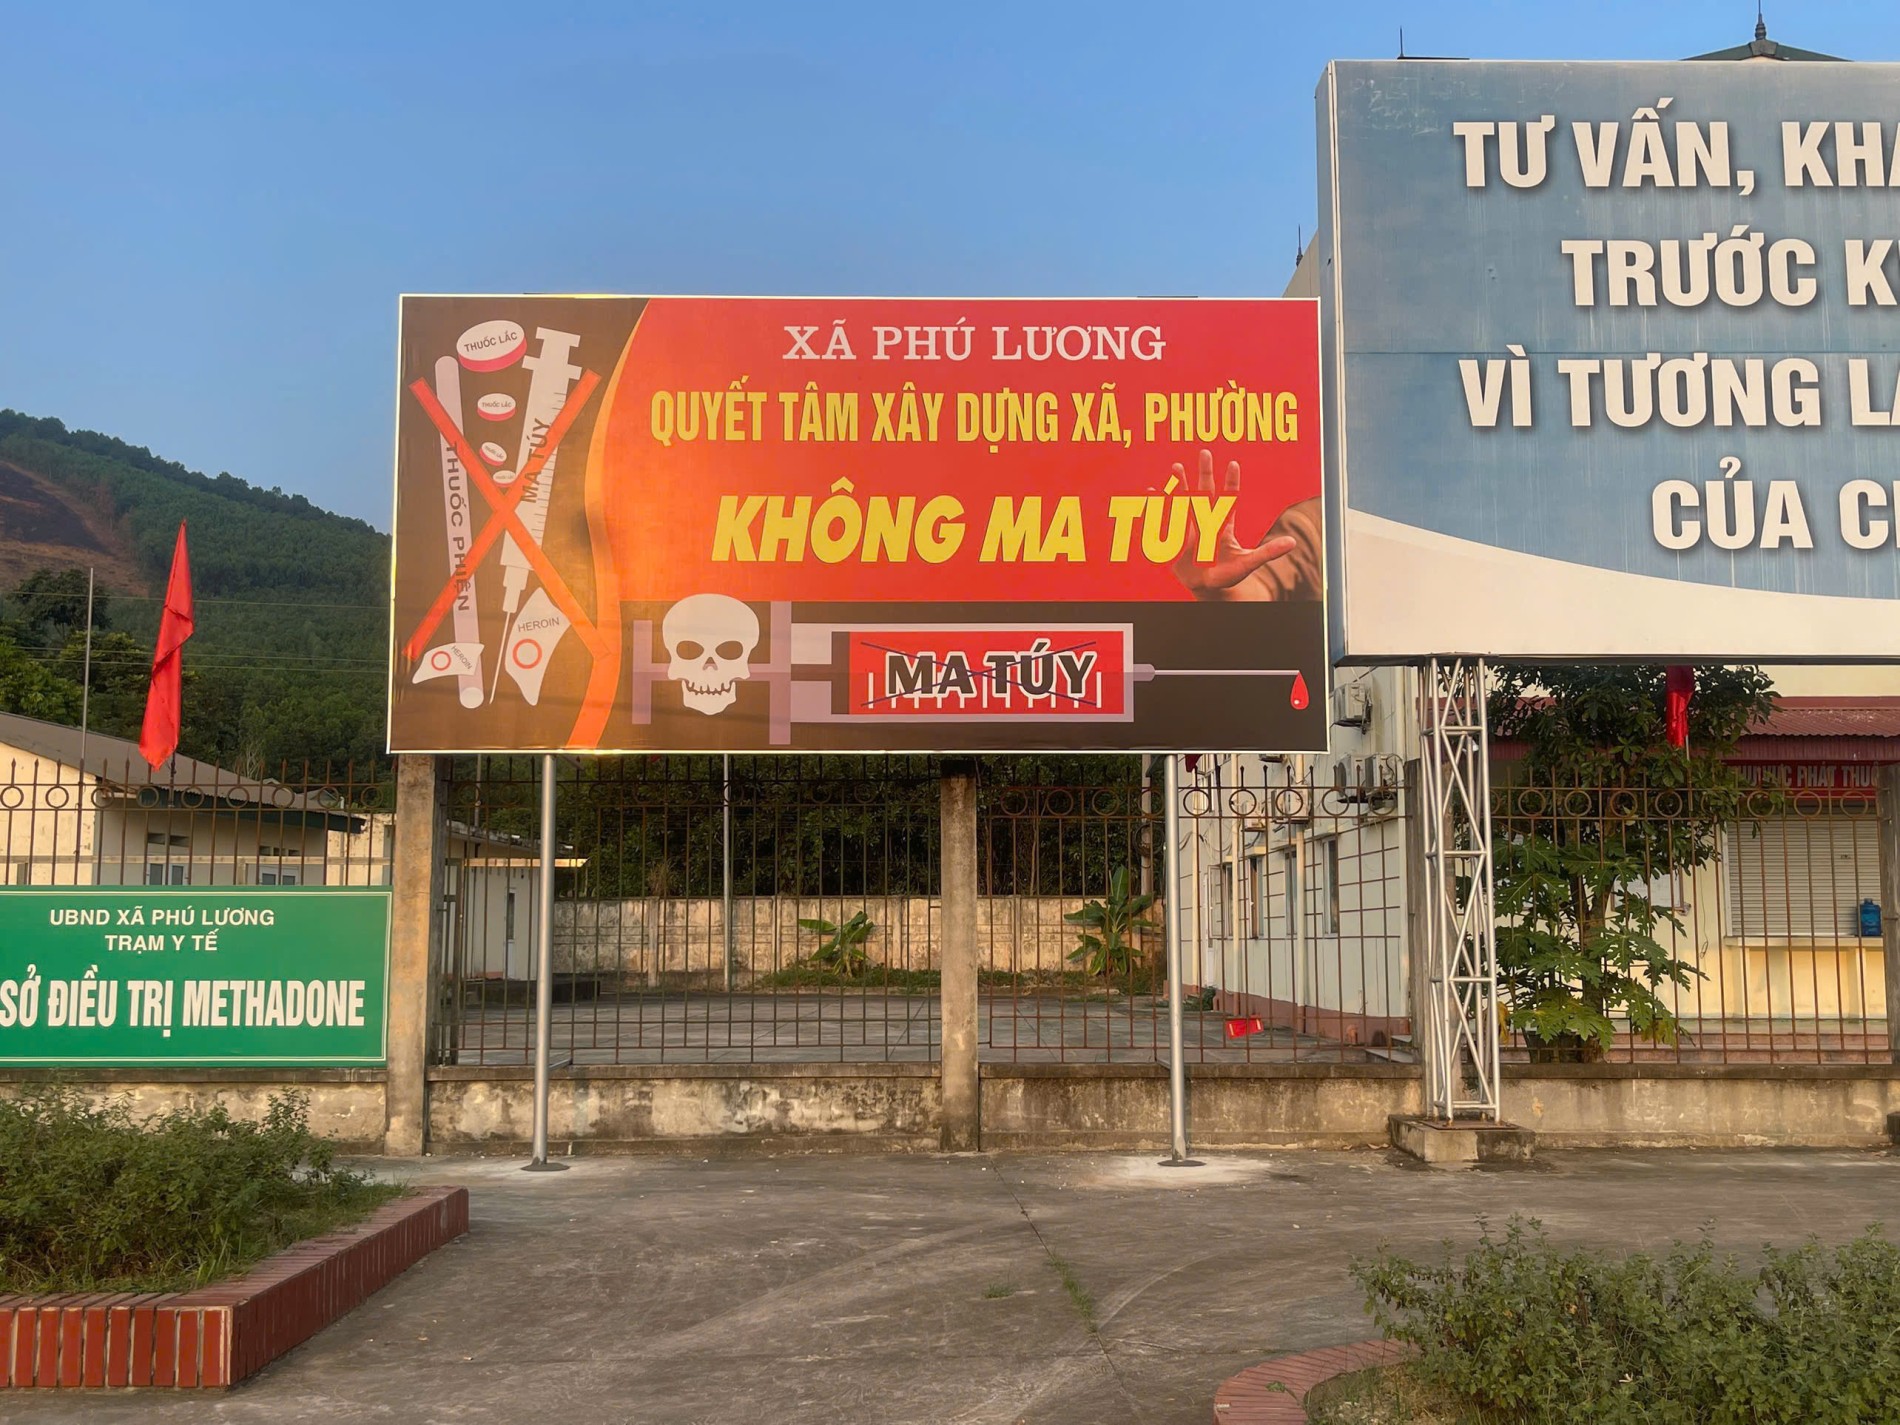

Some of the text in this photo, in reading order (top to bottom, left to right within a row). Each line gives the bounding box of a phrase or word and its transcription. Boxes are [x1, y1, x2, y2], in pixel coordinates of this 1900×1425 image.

[1453, 97, 1900, 196] TƯ VẤN, KH
[1561, 224, 1900, 308] TRƯỚC K
[464, 330, 518, 353] THUỐC LẮC
[782, 318, 1167, 362] XÃ PHÚ LƯƠNG
[650, 375, 1299, 453] QUYẾT TÂM XÂY DỰNG XÃ, PHƯỜNG
[1458, 344, 1900, 428] VÌ TƯƠNG L
[446, 442, 467, 527] THUỐC
[520, 418, 551, 503] MA TÚY
[711, 474, 1238, 564] KHÔNG MA TÚY
[1651, 456, 1900, 551] CỦA C
[517, 617, 560, 633] HEROIN
[885, 637, 1098, 700] MA TÚY
[50, 905, 275, 926] UBND XÃ PHÚ LƯƠNG
[105, 928, 220, 954] TRẠM Y TẾ
[0, 964, 366, 1038] SỞ ĐIỀU TRỊ METHADONE
